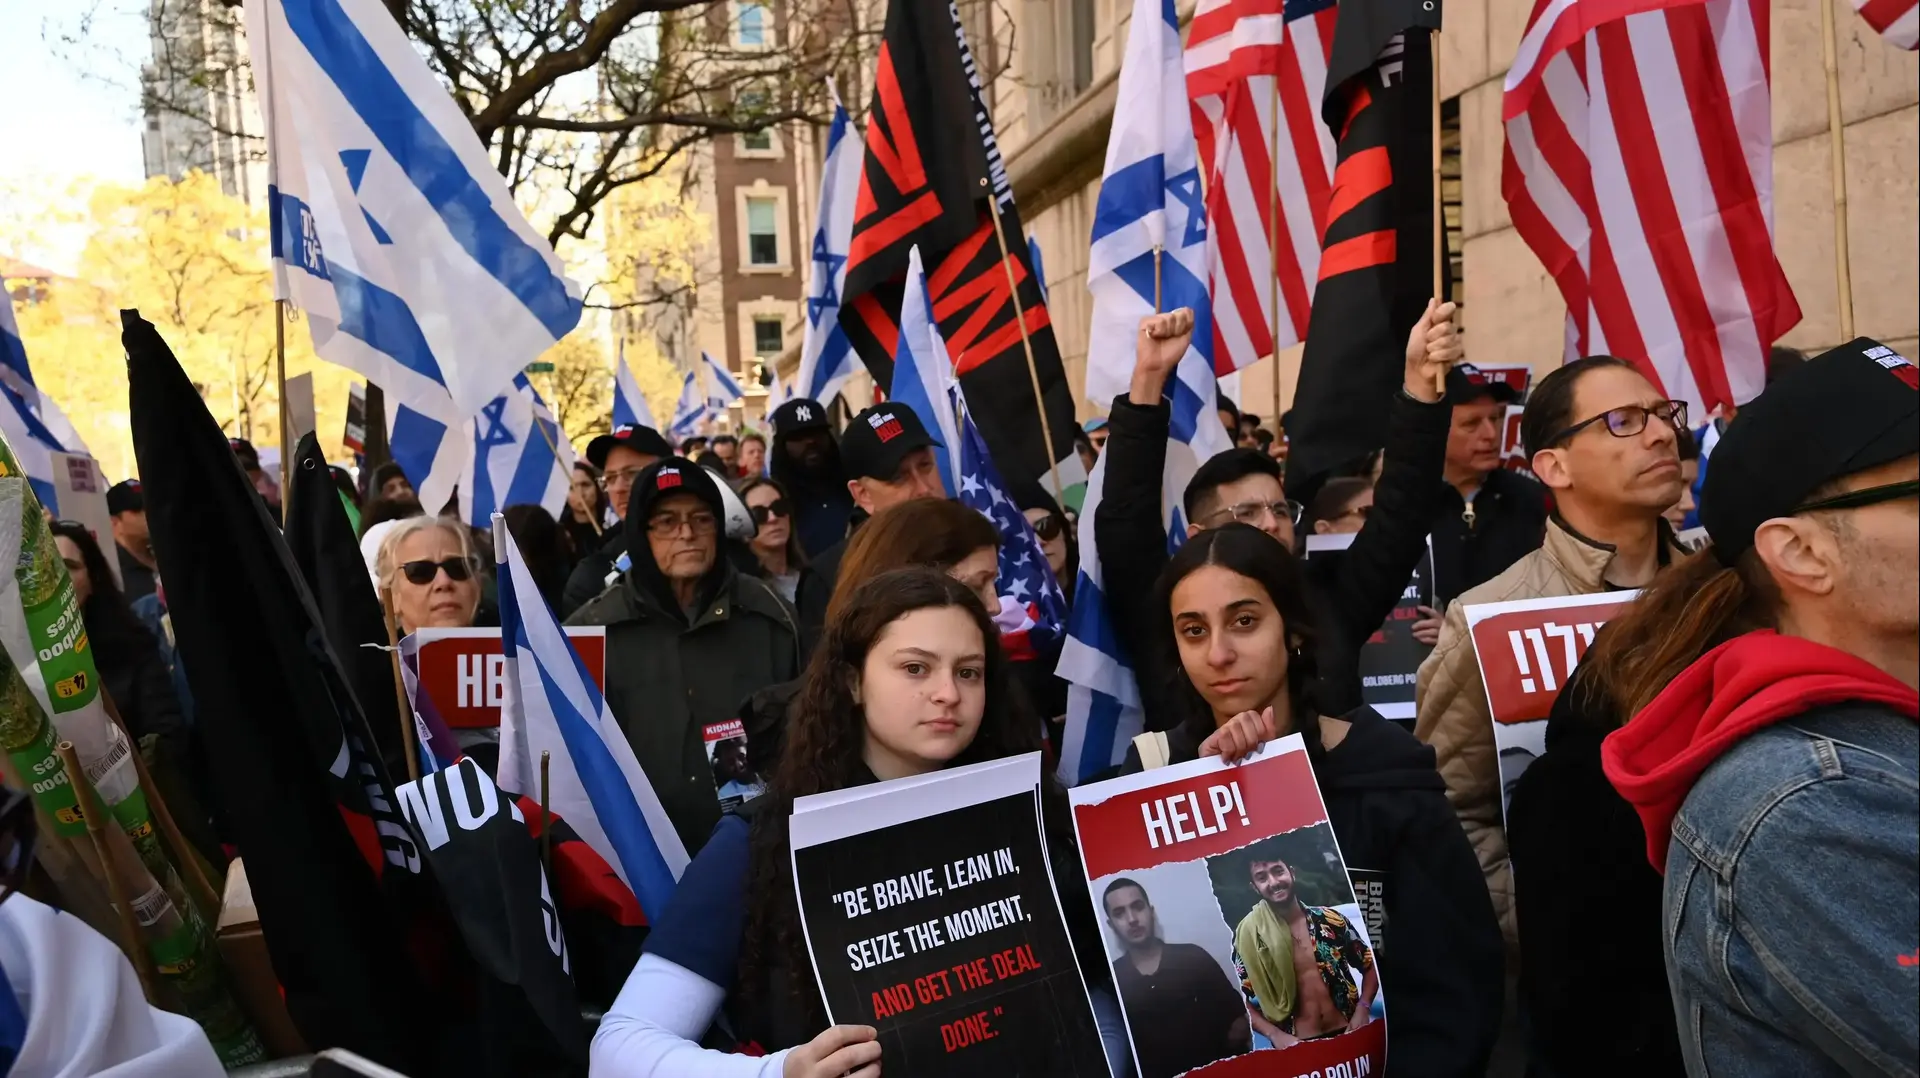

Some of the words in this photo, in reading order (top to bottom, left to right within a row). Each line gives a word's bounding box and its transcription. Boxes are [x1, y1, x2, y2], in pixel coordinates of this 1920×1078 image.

[1141, 781, 1250, 848] HELP!
[833, 887, 871, 918] "BE
[873, 868, 943, 911] BRAVE,
[944, 853, 991, 890] LEAN
[993, 847, 1020, 876] IN,
[846, 931, 905, 972] SEIZE
[904, 919, 945, 954] THE
[944, 895, 1031, 943] MOMENT,
[871, 984, 915, 1020] AND
[914, 970, 953, 1005] GET
[952, 958, 993, 993] THE
[991, 944, 1042, 981] DEAL
[941, 1006, 1004, 1053] DONE."
